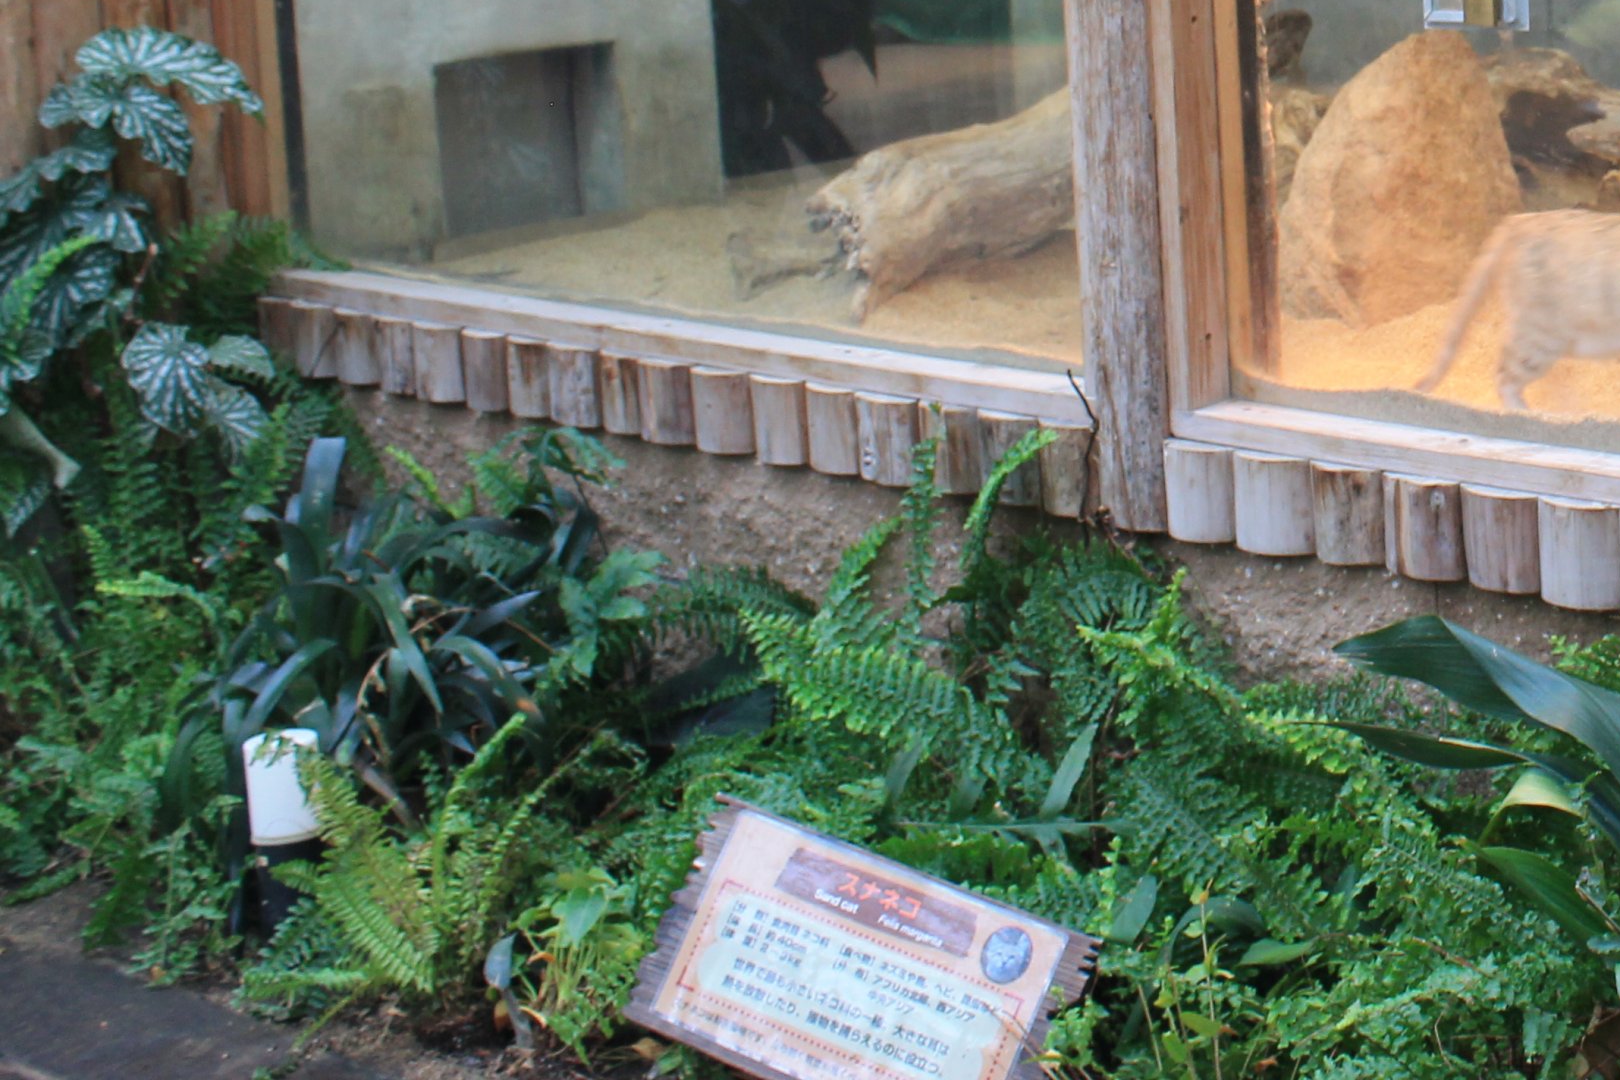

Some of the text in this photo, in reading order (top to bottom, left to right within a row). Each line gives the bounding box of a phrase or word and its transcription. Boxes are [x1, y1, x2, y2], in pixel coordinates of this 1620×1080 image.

[813, 887, 841, 907] Sand
[839, 898, 860, 915] cat
[836, 870, 923, 921] スナネコ
